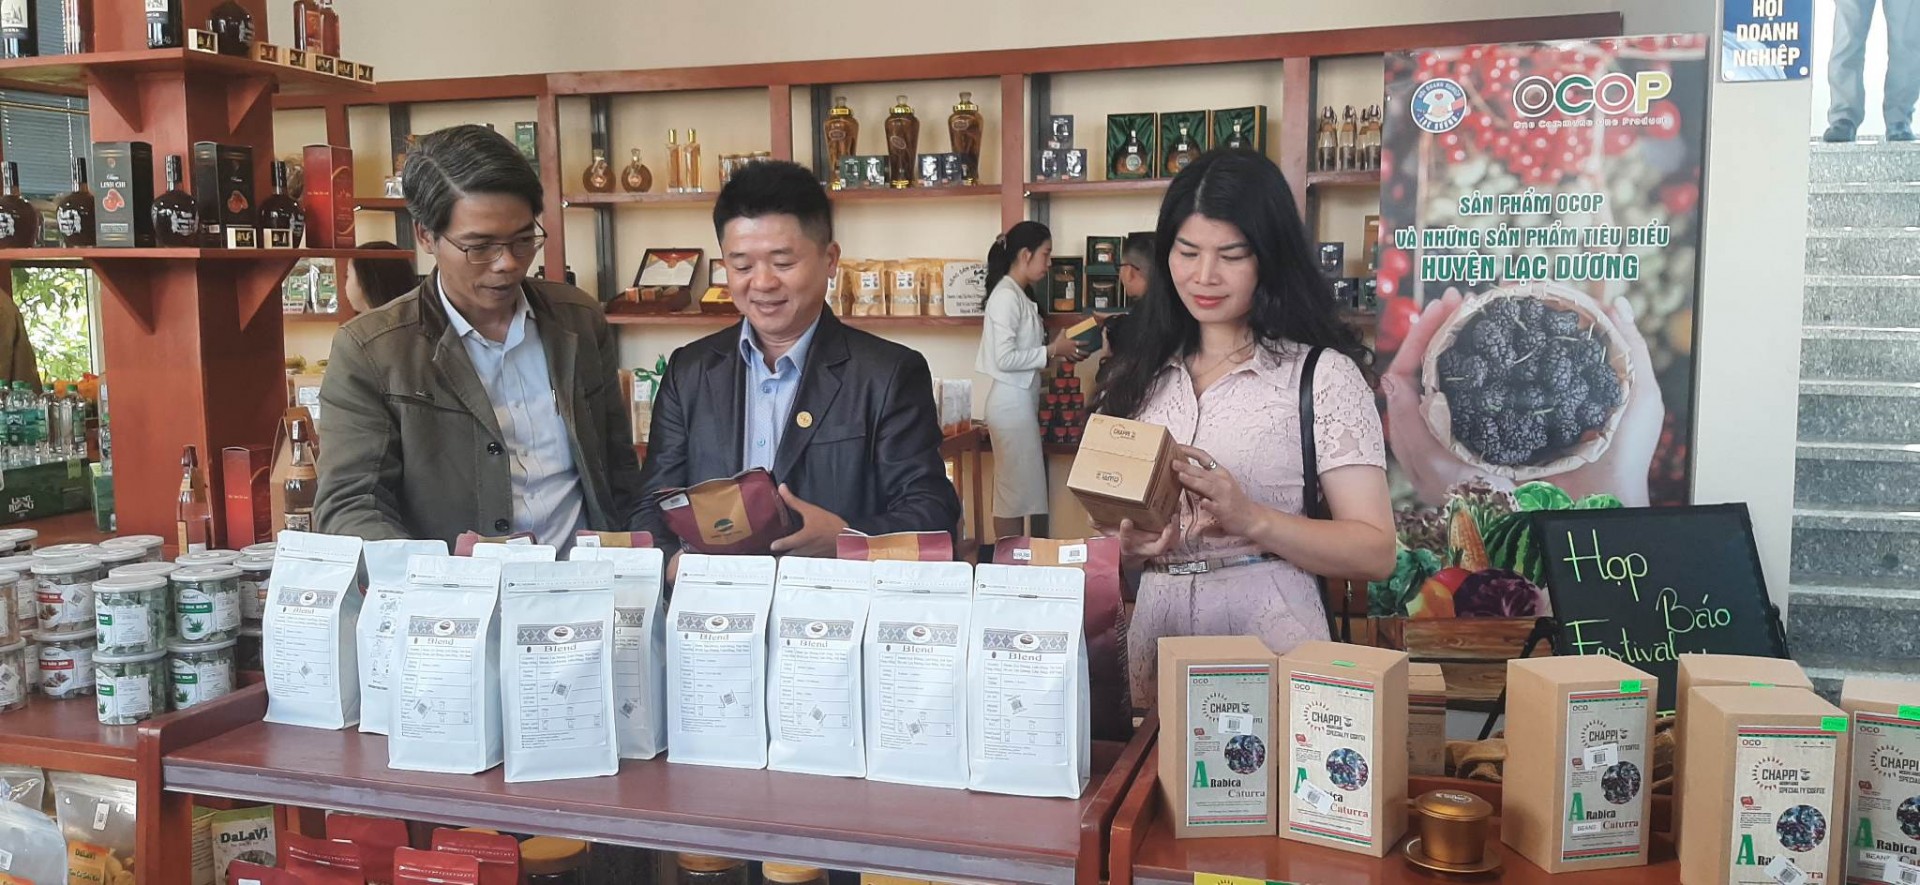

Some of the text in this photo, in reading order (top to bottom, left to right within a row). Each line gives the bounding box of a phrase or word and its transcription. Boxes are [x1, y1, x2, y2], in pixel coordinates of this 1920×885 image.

[1736, 22, 1798, 42] DOANH
[1733, 44, 1800, 70] NGHIỆP
[1513, 71, 1672, 118] OCOP
[1459, 187, 1604, 214] SẢN PHẨM OCOP
[1395, 219, 1669, 248] VÀ NHỮNG SẢN PHẨM TIÊU BIỂU
[1420, 251, 1639, 286] HUYỆN LẠC DƯƠNG
[1563, 528, 1648, 602] Họp
[1656, 587, 1731, 633] Báo
[903, 644, 933, 653] Blend
[1008, 652, 1042, 661] Blend
[1210, 703, 1240, 713] CHAPPI
[1312, 711, 1342, 726] CHAPPI
[1589, 729, 1618, 742] CHAPPI
[1880, 756, 1919, 771] CHAPPI
[1761, 769, 1798, 780] CHAPPI
